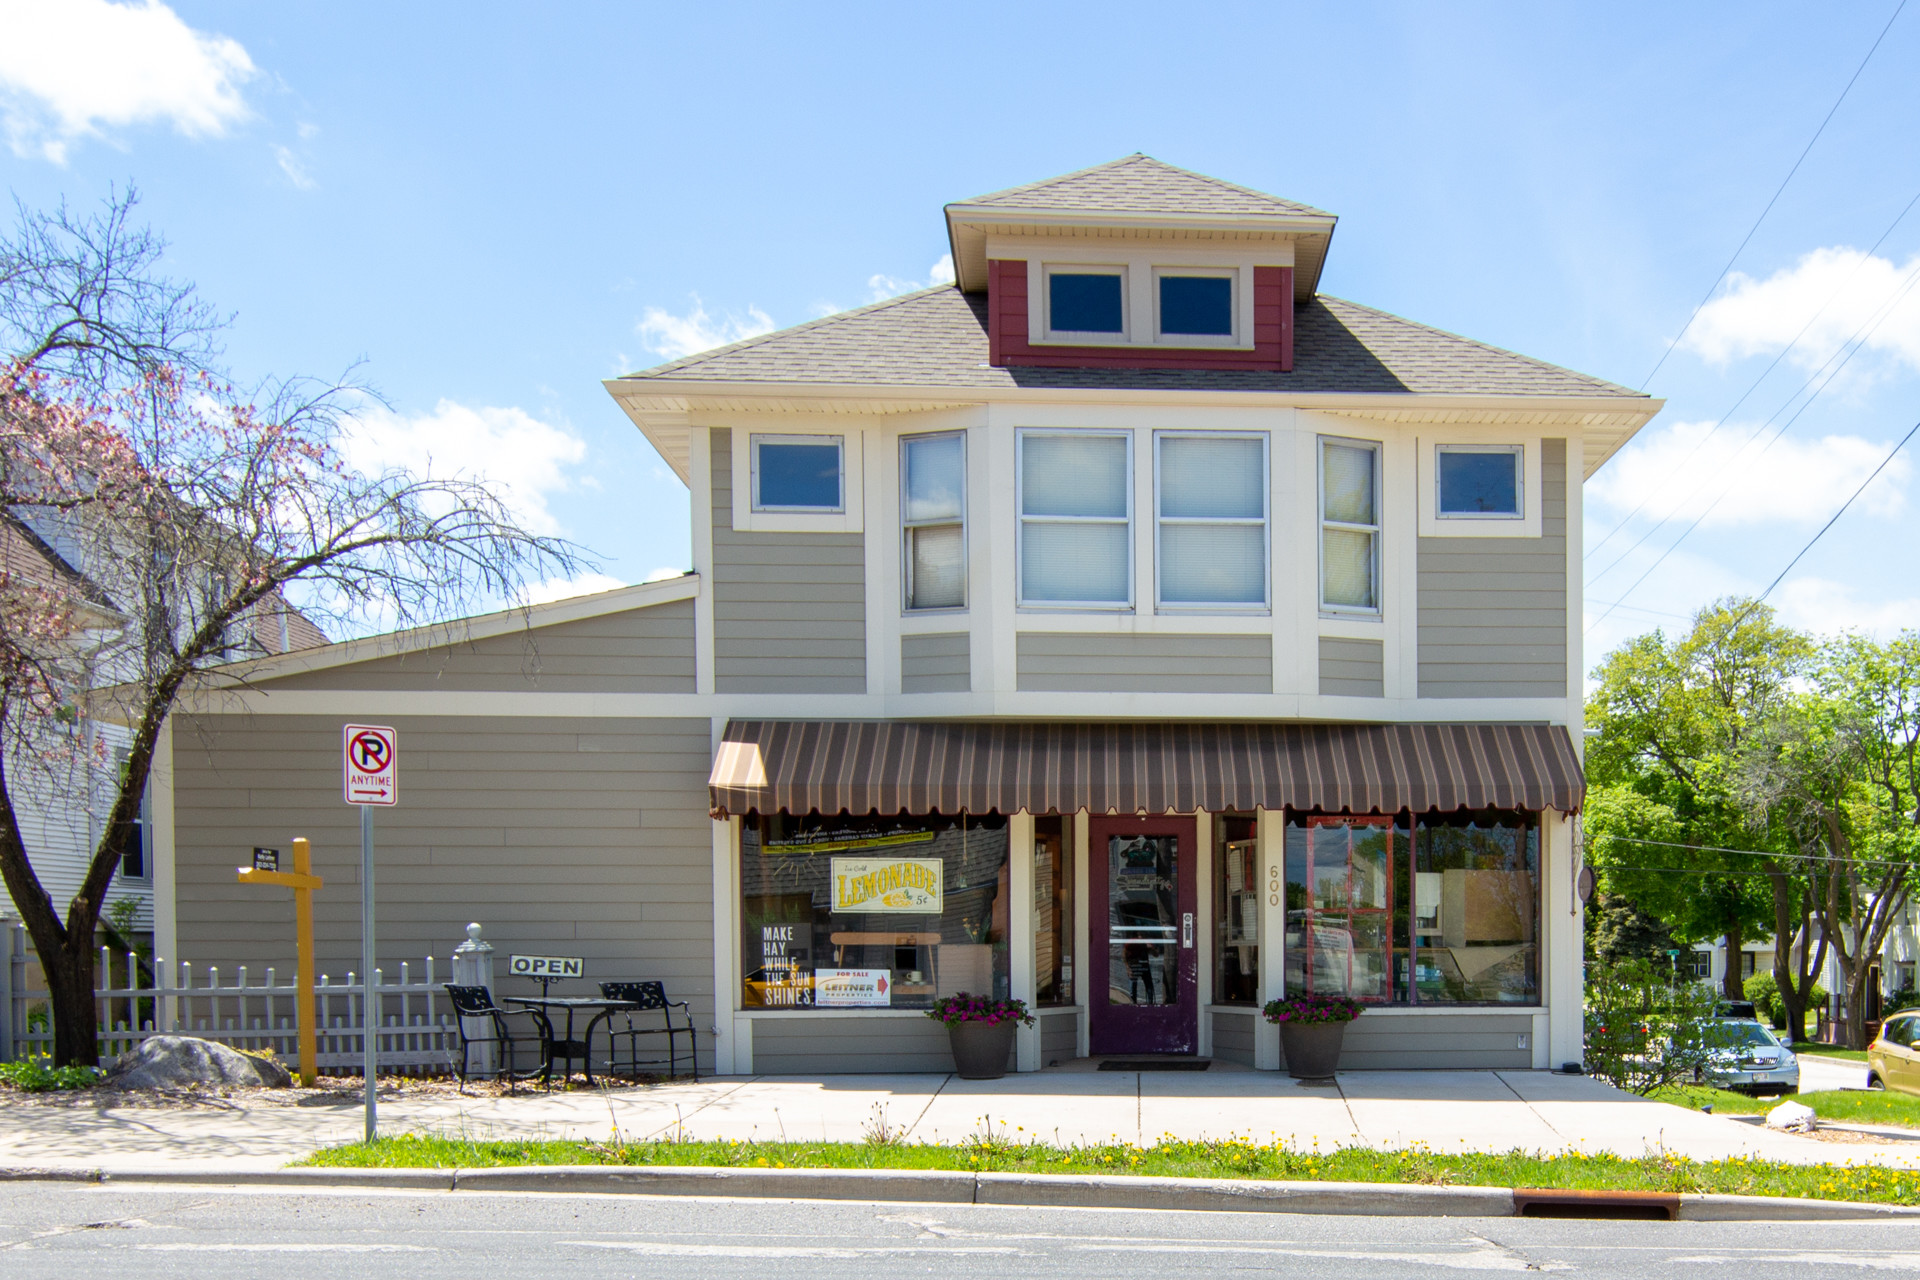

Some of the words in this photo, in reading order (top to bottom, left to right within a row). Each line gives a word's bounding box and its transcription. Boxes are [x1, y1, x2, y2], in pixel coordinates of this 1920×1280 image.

[351, 775, 392, 787] ANYTIME
[854, 864, 868, 872] Cold
[837, 862, 937, 908] LEMONADE
[1270, 865, 1280, 907] 600
[916, 895, 929, 906] 5¢
[763, 926, 794, 941] MAKE
[763, 942, 786, 956] HAY
[514, 958, 579, 974] OPEN
[764, 956, 797, 971] WHILE
[765, 972, 785, 986] THE
[790, 972, 810, 986] SUN
[824, 983, 875, 991] LEITNER
[765, 987, 815, 1005] SHINES.
